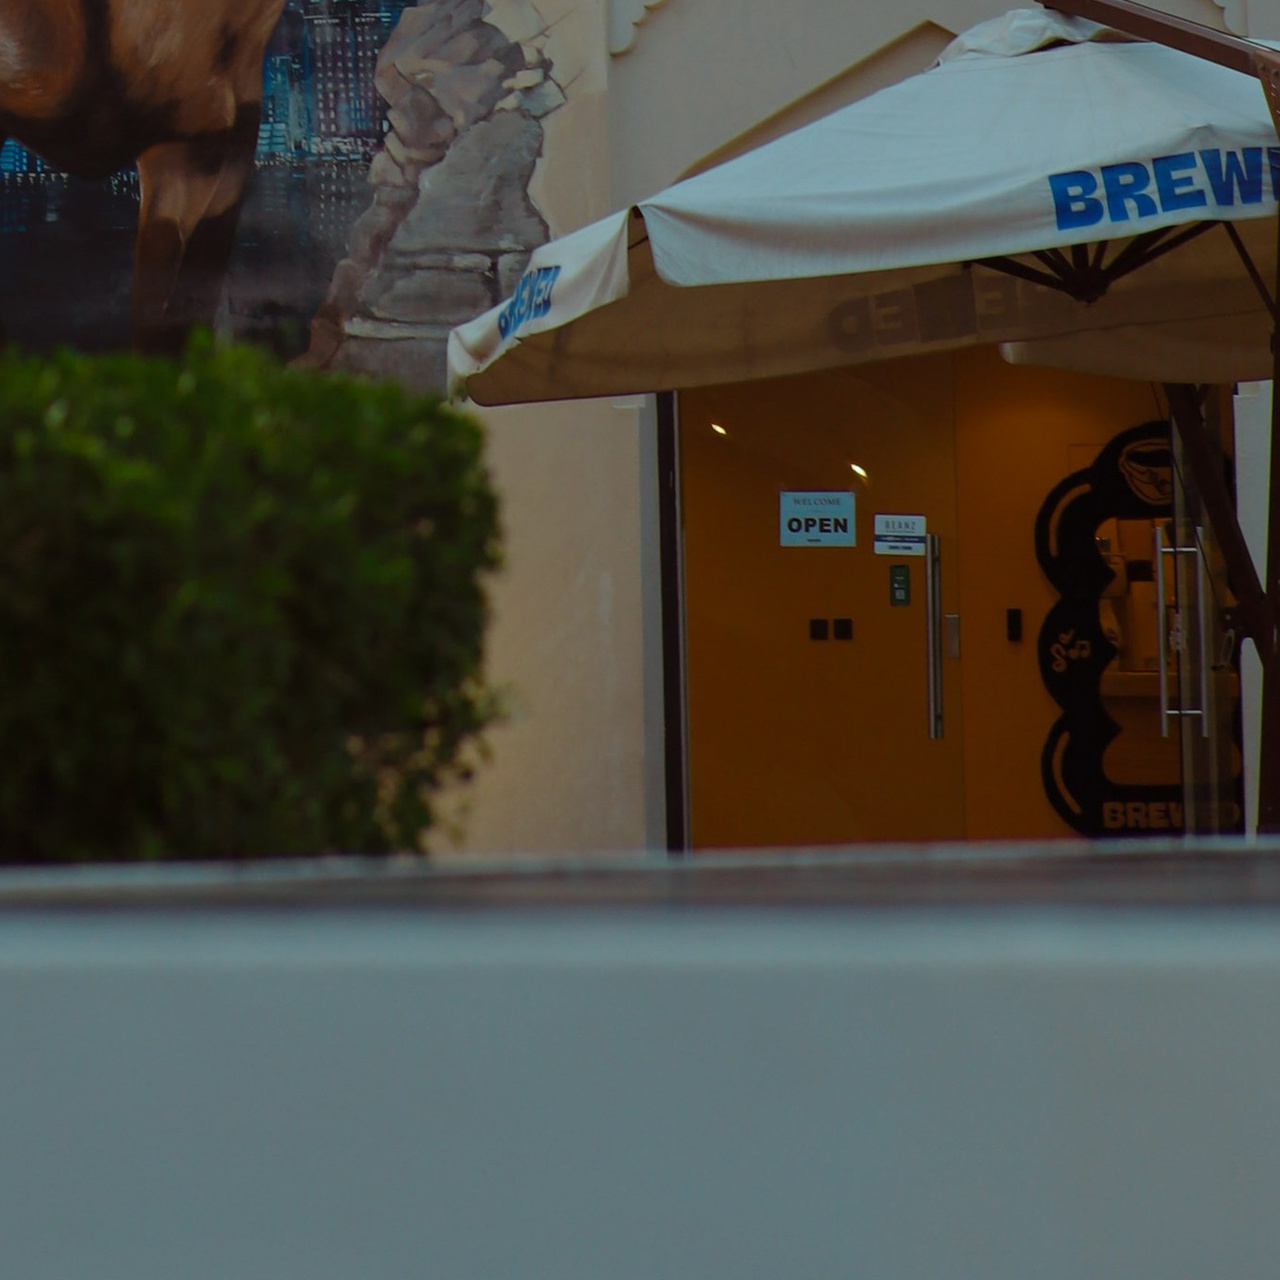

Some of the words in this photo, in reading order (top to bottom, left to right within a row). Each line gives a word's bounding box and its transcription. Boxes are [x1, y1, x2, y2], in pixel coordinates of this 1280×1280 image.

[1048, 147, 1280, 230] BREW
[793, 498, 841, 506] WELCOME
[787, 517, 848, 533] OPEN
